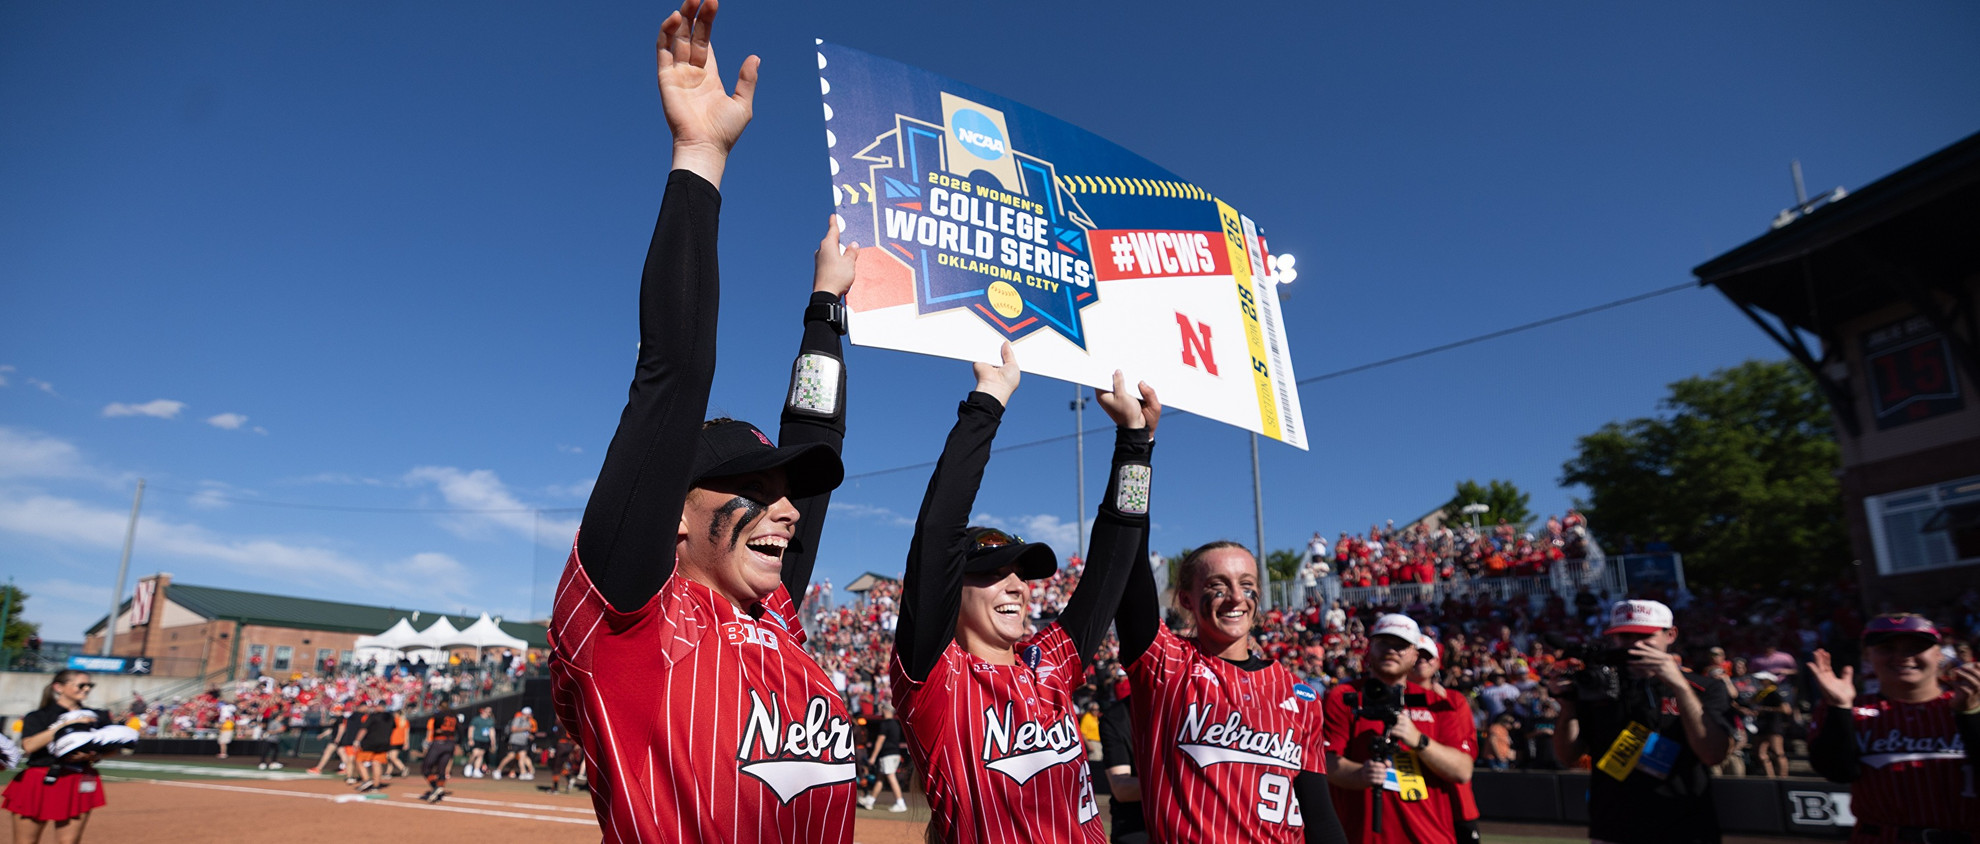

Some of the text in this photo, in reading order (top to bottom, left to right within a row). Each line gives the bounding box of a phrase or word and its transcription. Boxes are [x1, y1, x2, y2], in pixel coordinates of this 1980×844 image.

[959, 127, 1005, 154] NCAA
[928, 171, 1044, 215] 2026 WOMEN'S
[929, 187, 1048, 246] COLLEGE
[1223, 212, 1244, 251] 26
[885, 207, 1090, 288] WORLD SERIES
[1110, 232, 1216, 275] #WCWS
[938, 252, 1059, 294] OKLAHOMA CITY
[1238, 283, 1258, 322] 28
[1175, 311, 1219, 377] N
[1252, 356, 1269, 378] 5
[736, 687, 856, 761] Nebr
[1855, 728, 1966, 754] Nebrask
